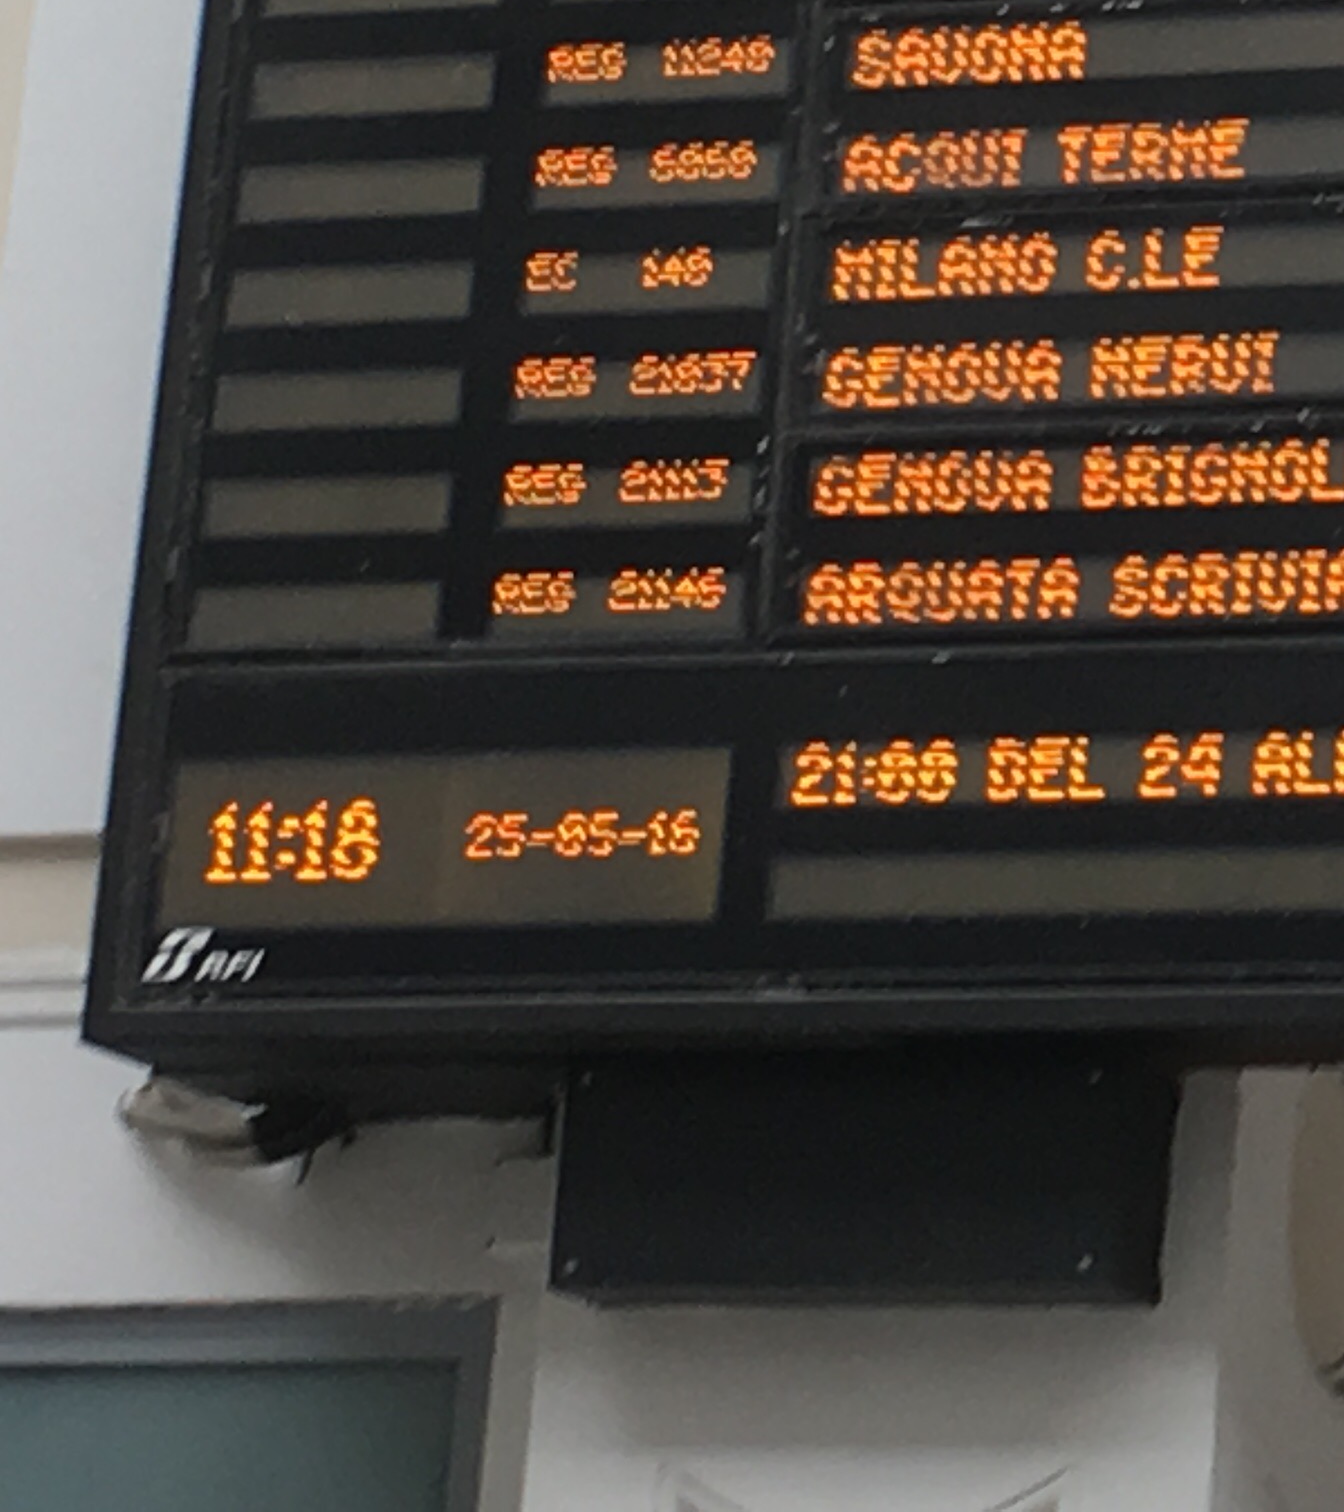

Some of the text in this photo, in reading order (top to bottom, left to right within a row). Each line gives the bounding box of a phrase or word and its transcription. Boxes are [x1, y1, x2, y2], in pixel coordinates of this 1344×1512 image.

[547, 42, 628, 83] REG
[851, 20, 1088, 89] SAVONA
[534, 146, 618, 188] REG
[842, 117, 1250, 193] ACQUI TERME
[525, 251, 578, 292] EC
[832, 225, 1224, 301] MILANO C.LE
[514, 356, 597, 399] REG
[821, 331, 1279, 409] GENOVA NERVI
[503, 463, 587, 507] REG
[813, 449, 1054, 516] GENOVA
[492, 571, 576, 615] REG
[803, 556, 1081, 626] ARQUATA
[789, 738, 959, 807] 21:00
[984, 736, 1106, 803] DEL
[1137, 732, 1224, 799] 24
[203, 796, 381, 885] 11:18
[463, 808, 701, 861] 25-05-16
